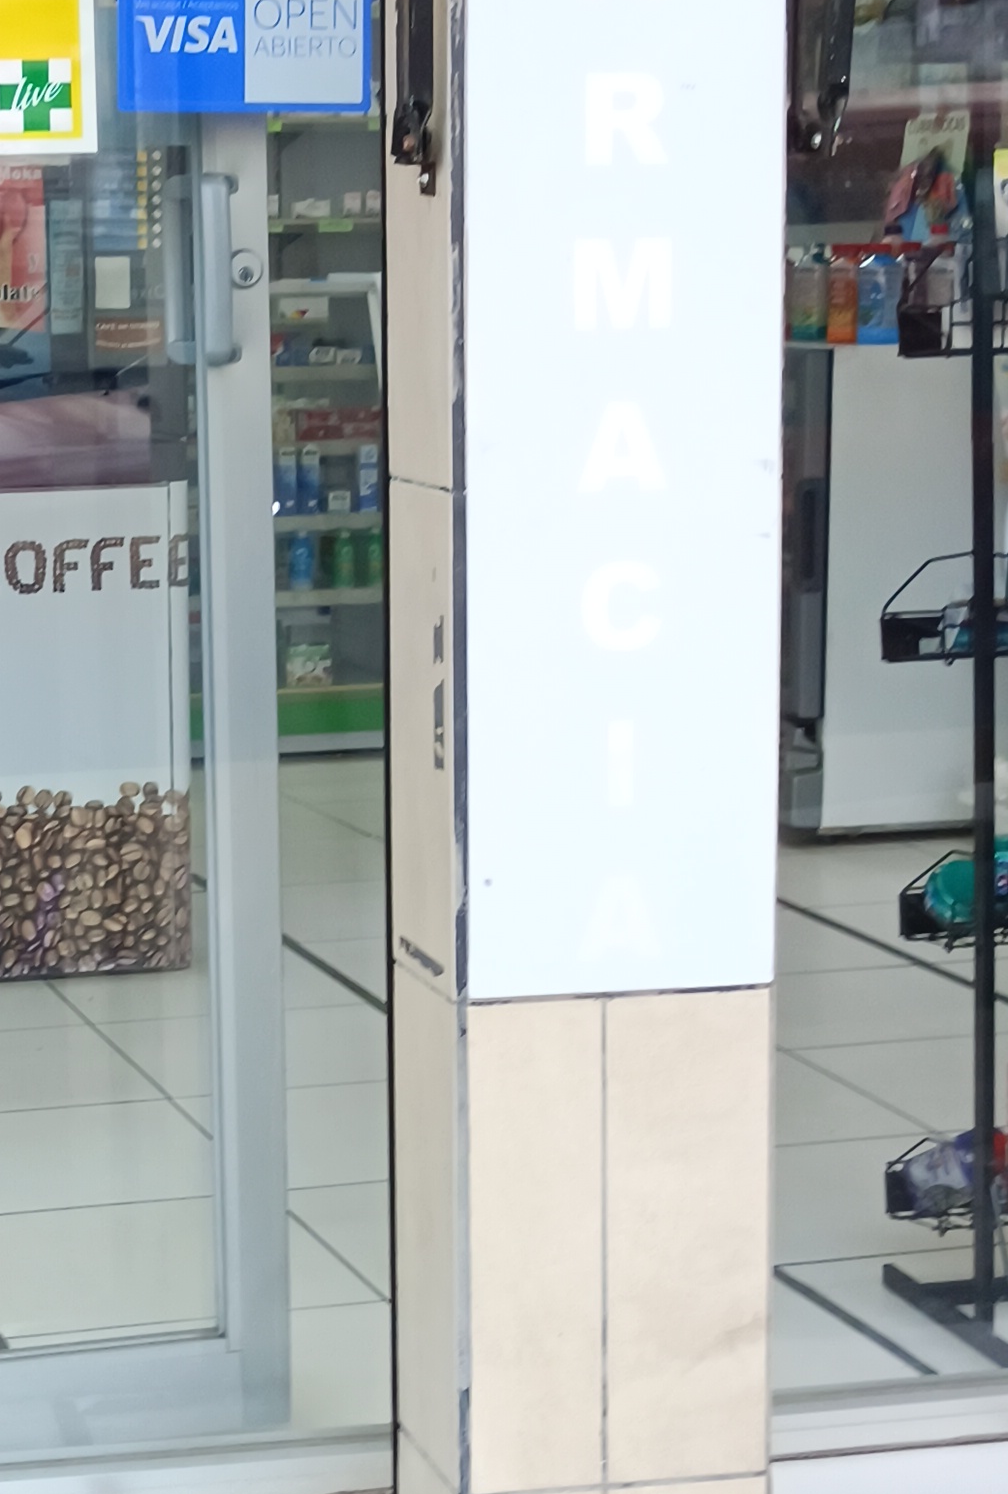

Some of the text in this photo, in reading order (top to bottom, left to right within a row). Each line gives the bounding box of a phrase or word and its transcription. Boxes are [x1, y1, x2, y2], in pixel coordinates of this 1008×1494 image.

[135, 15, 238, 54] VISA
[253, 35, 358, 58] ABIERTO
[10, 75, 65, 111] live
